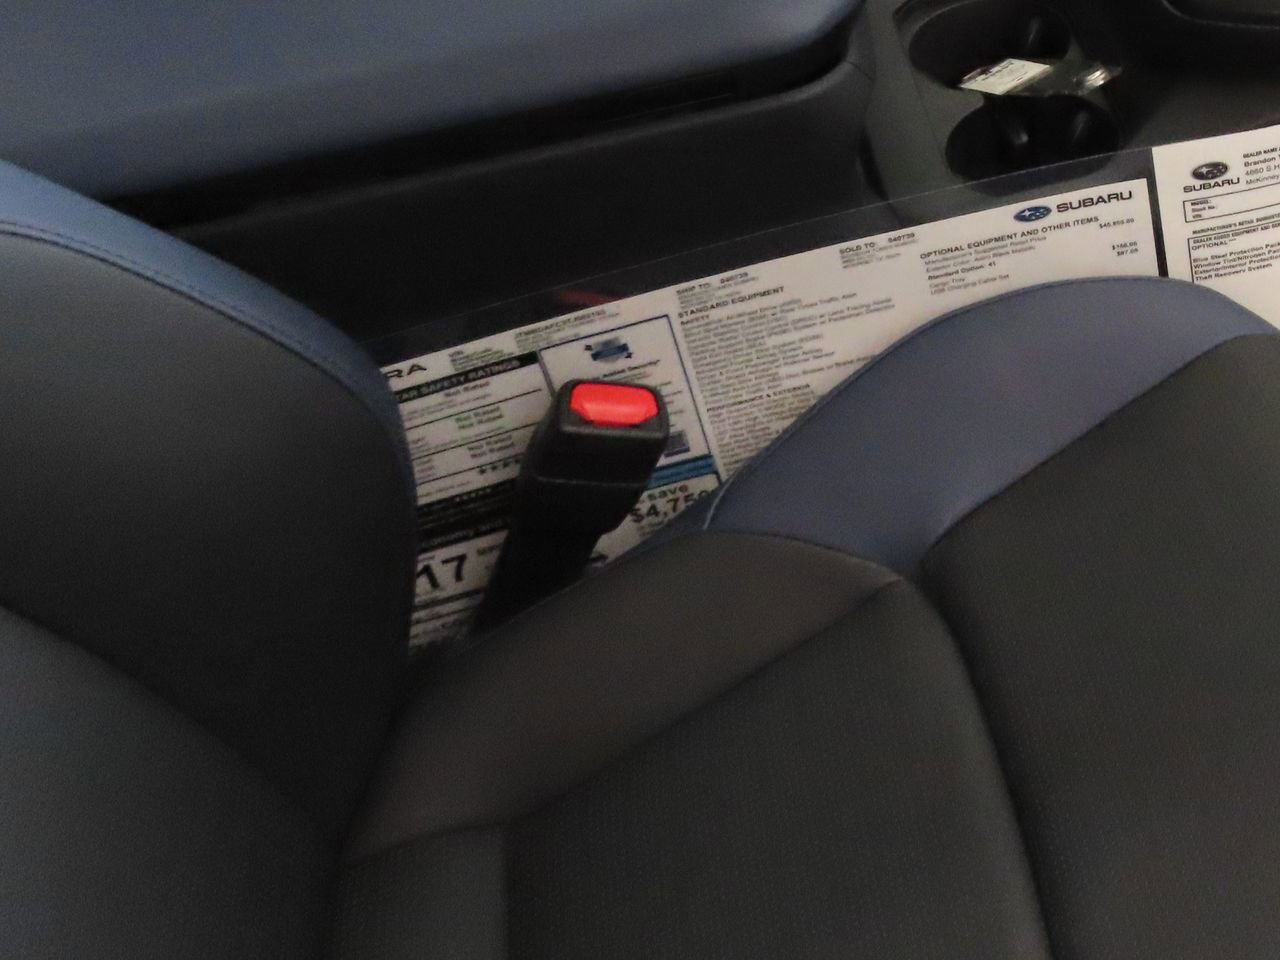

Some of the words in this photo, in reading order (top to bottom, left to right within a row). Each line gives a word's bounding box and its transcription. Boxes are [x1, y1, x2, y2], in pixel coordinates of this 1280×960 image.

[1244, 156, 1276, 168] Brandon
[1183, 177, 1240, 193] SUBARU
[1056, 190, 1132, 213] SUBARU
[920, 245, 965, 259] OPTIONAL
[967, 232, 1018, 249] EQUIPMENT
[1020, 228, 1039, 238] AND
[1041, 221, 1071, 233] OTHER
[1073, 216, 1100, 227] ITEMS
[1191, 240, 1229, 251] OPTIONAL
[678, 300, 729, 319] STANDARD
[731, 286, 785, 305] EQUIPMENT
[647, 484, 689, 501] save
